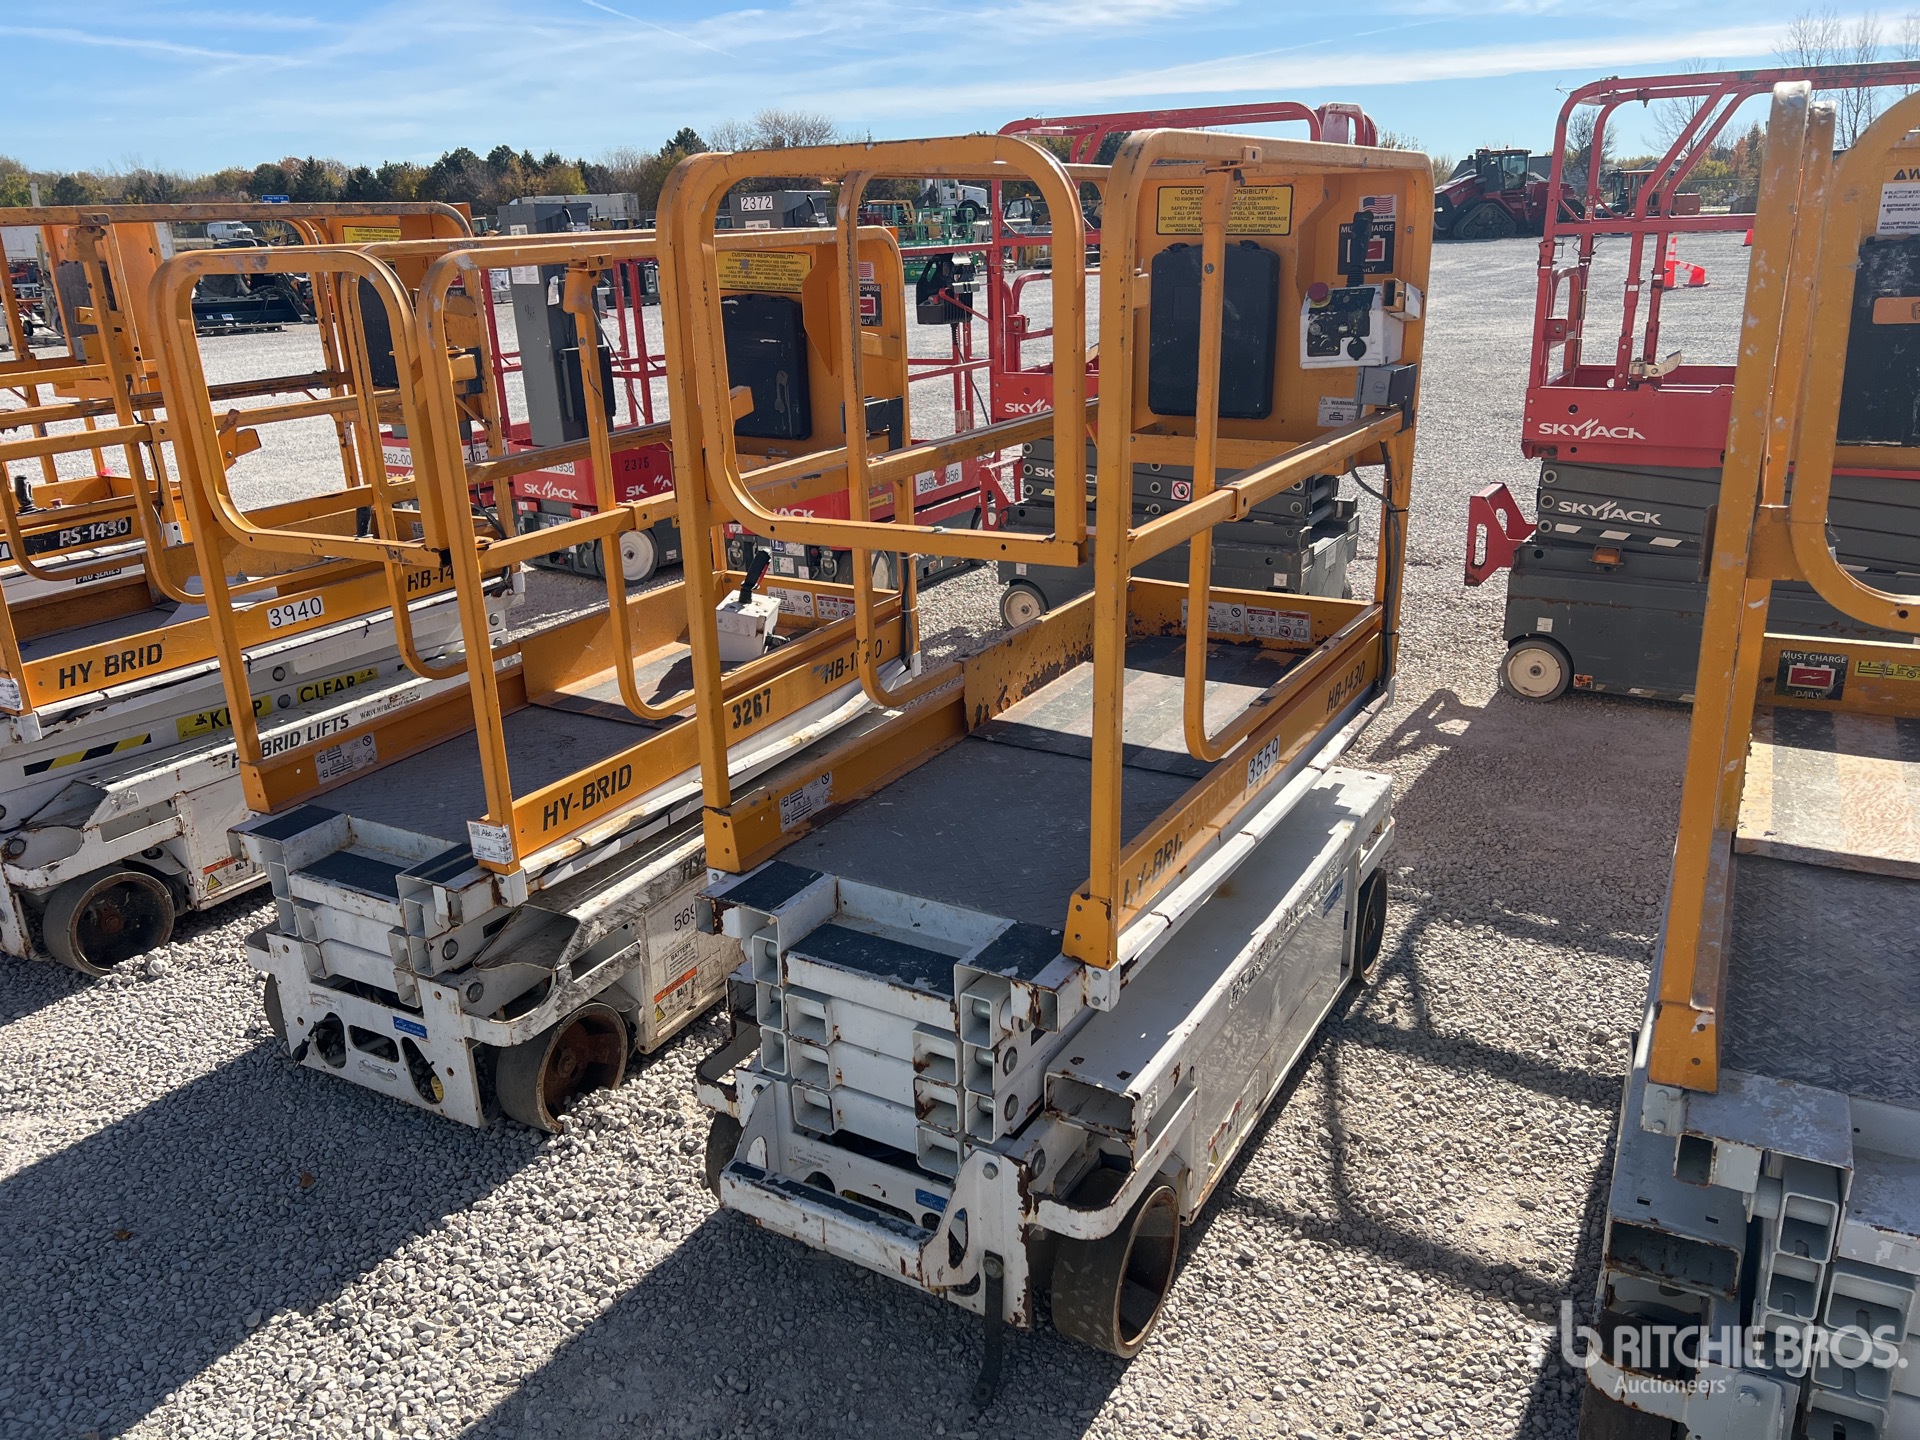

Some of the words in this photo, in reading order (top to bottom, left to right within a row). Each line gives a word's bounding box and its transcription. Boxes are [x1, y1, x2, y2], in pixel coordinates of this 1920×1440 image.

[742, 196, 771, 210] 2372
[1539, 418, 1646, 439] SKYJACK
[1558, 501, 1661, 525] SKYJACK
[408, 566, 454, 592] HB-14
[269, 597, 322, 627] 3940
[104, 643, 163, 677] BRID
[1782, 651, 1809, 660] MUST
[1809, 654, 1847, 663] CHARGE
[300, 675, 356, 702] CLEAR
[1795, 690, 1821, 699] DAILY
[732, 688, 771, 729] 3267
[307, 714, 349, 741] LIFTS
[1248, 737, 1279, 785] 3559
[542, 763, 632, 831] HY-BRID
[670, 942, 692, 961] BATTERY
